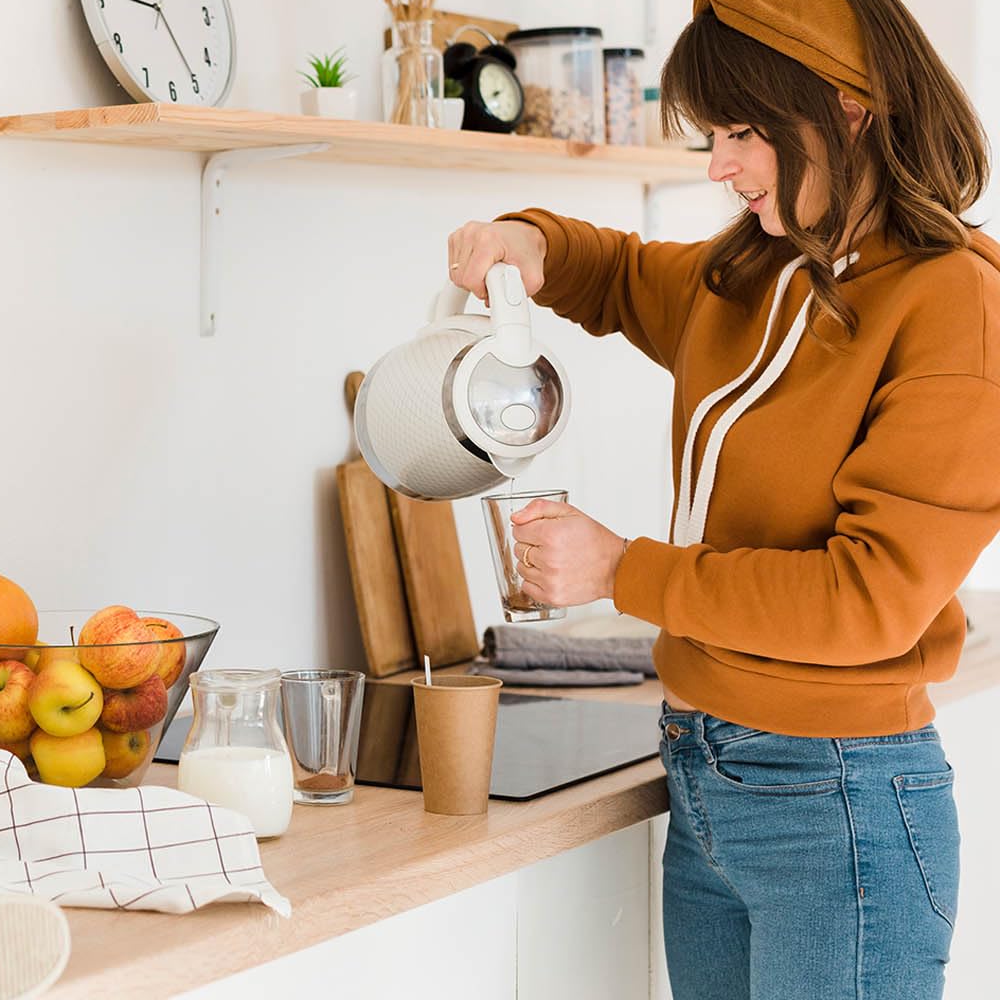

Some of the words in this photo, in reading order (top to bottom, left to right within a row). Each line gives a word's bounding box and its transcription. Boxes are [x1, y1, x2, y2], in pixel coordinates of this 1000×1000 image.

[142, 67, 150, 88] 7
[191, 74, 199, 94] 5
[169, 82, 177, 102] 6
